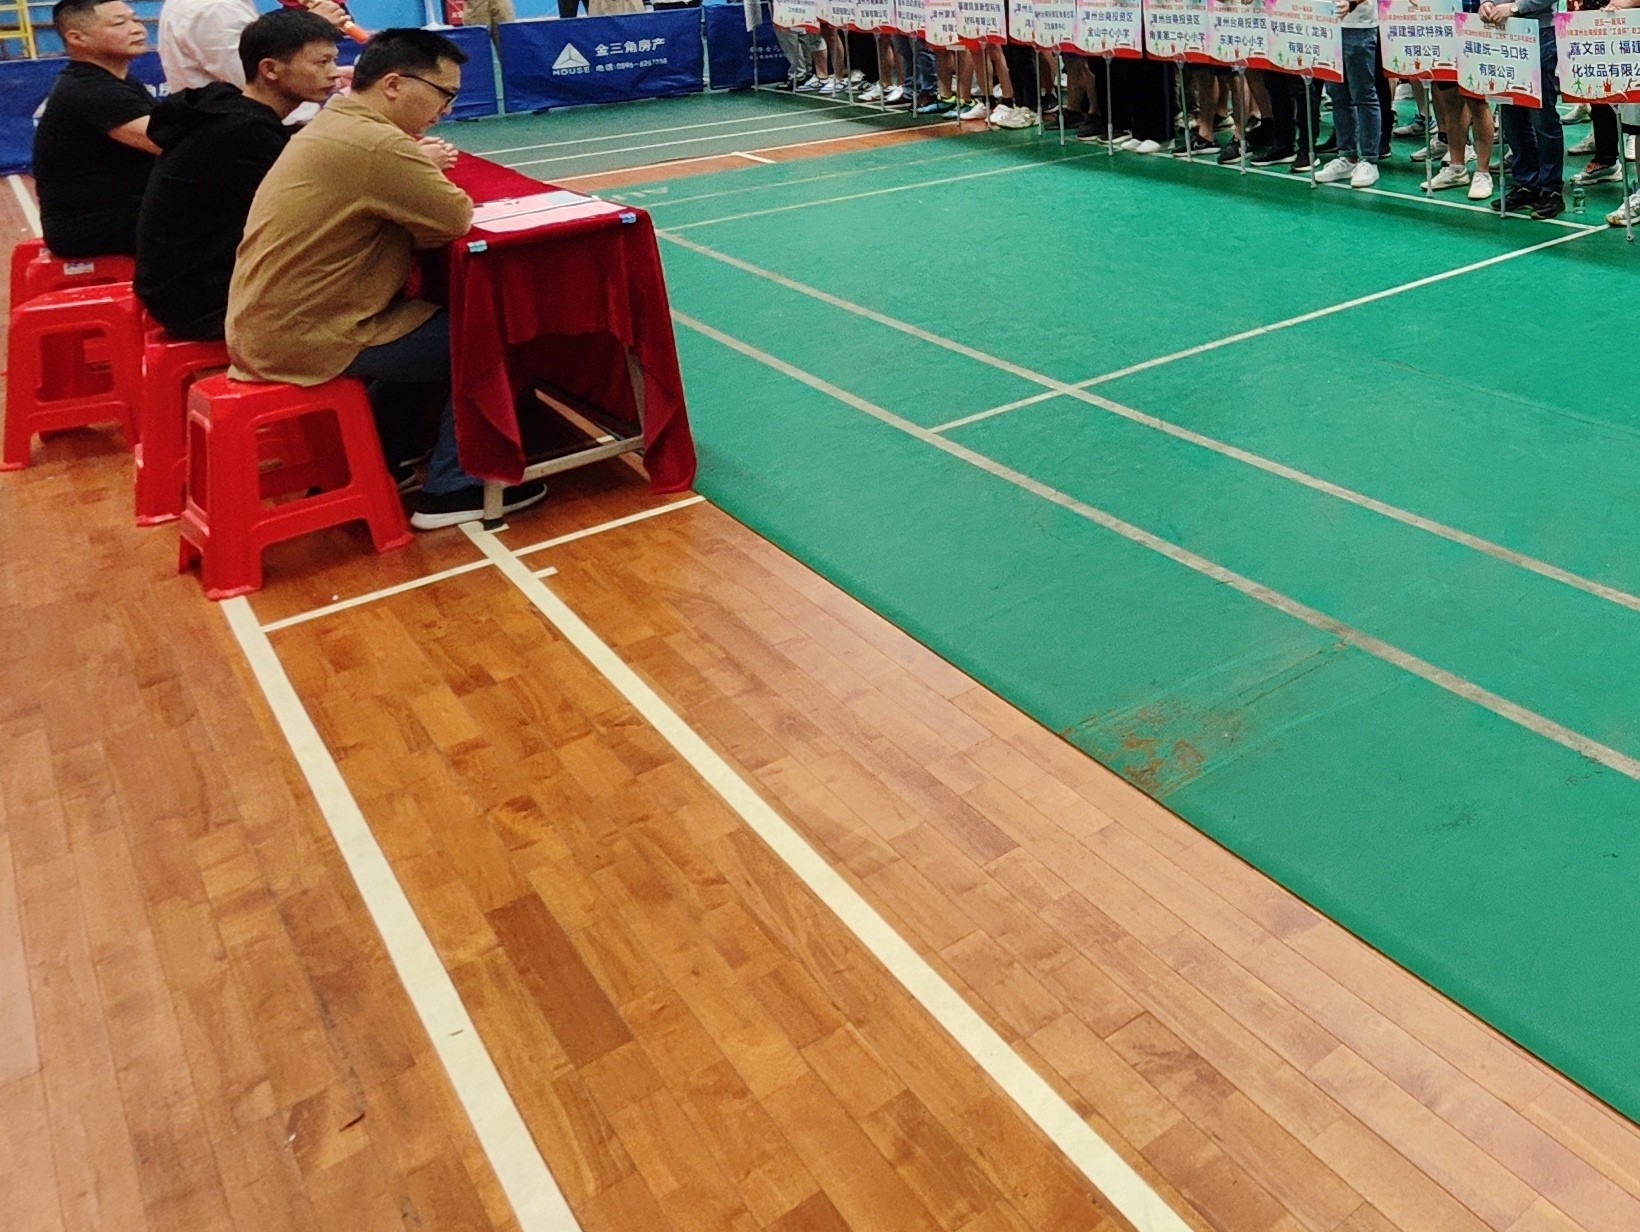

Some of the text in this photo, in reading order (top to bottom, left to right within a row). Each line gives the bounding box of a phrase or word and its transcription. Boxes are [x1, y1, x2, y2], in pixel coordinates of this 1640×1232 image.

[594, 37, 666, 57] 金三角房产
[1288, 41, 1321, 57] 有限公司
[1404, 45, 1441, 58] 有限公司
[552, 66, 591, 76] HOUSE
[1478, 63, 1516, 80] 有限公司
